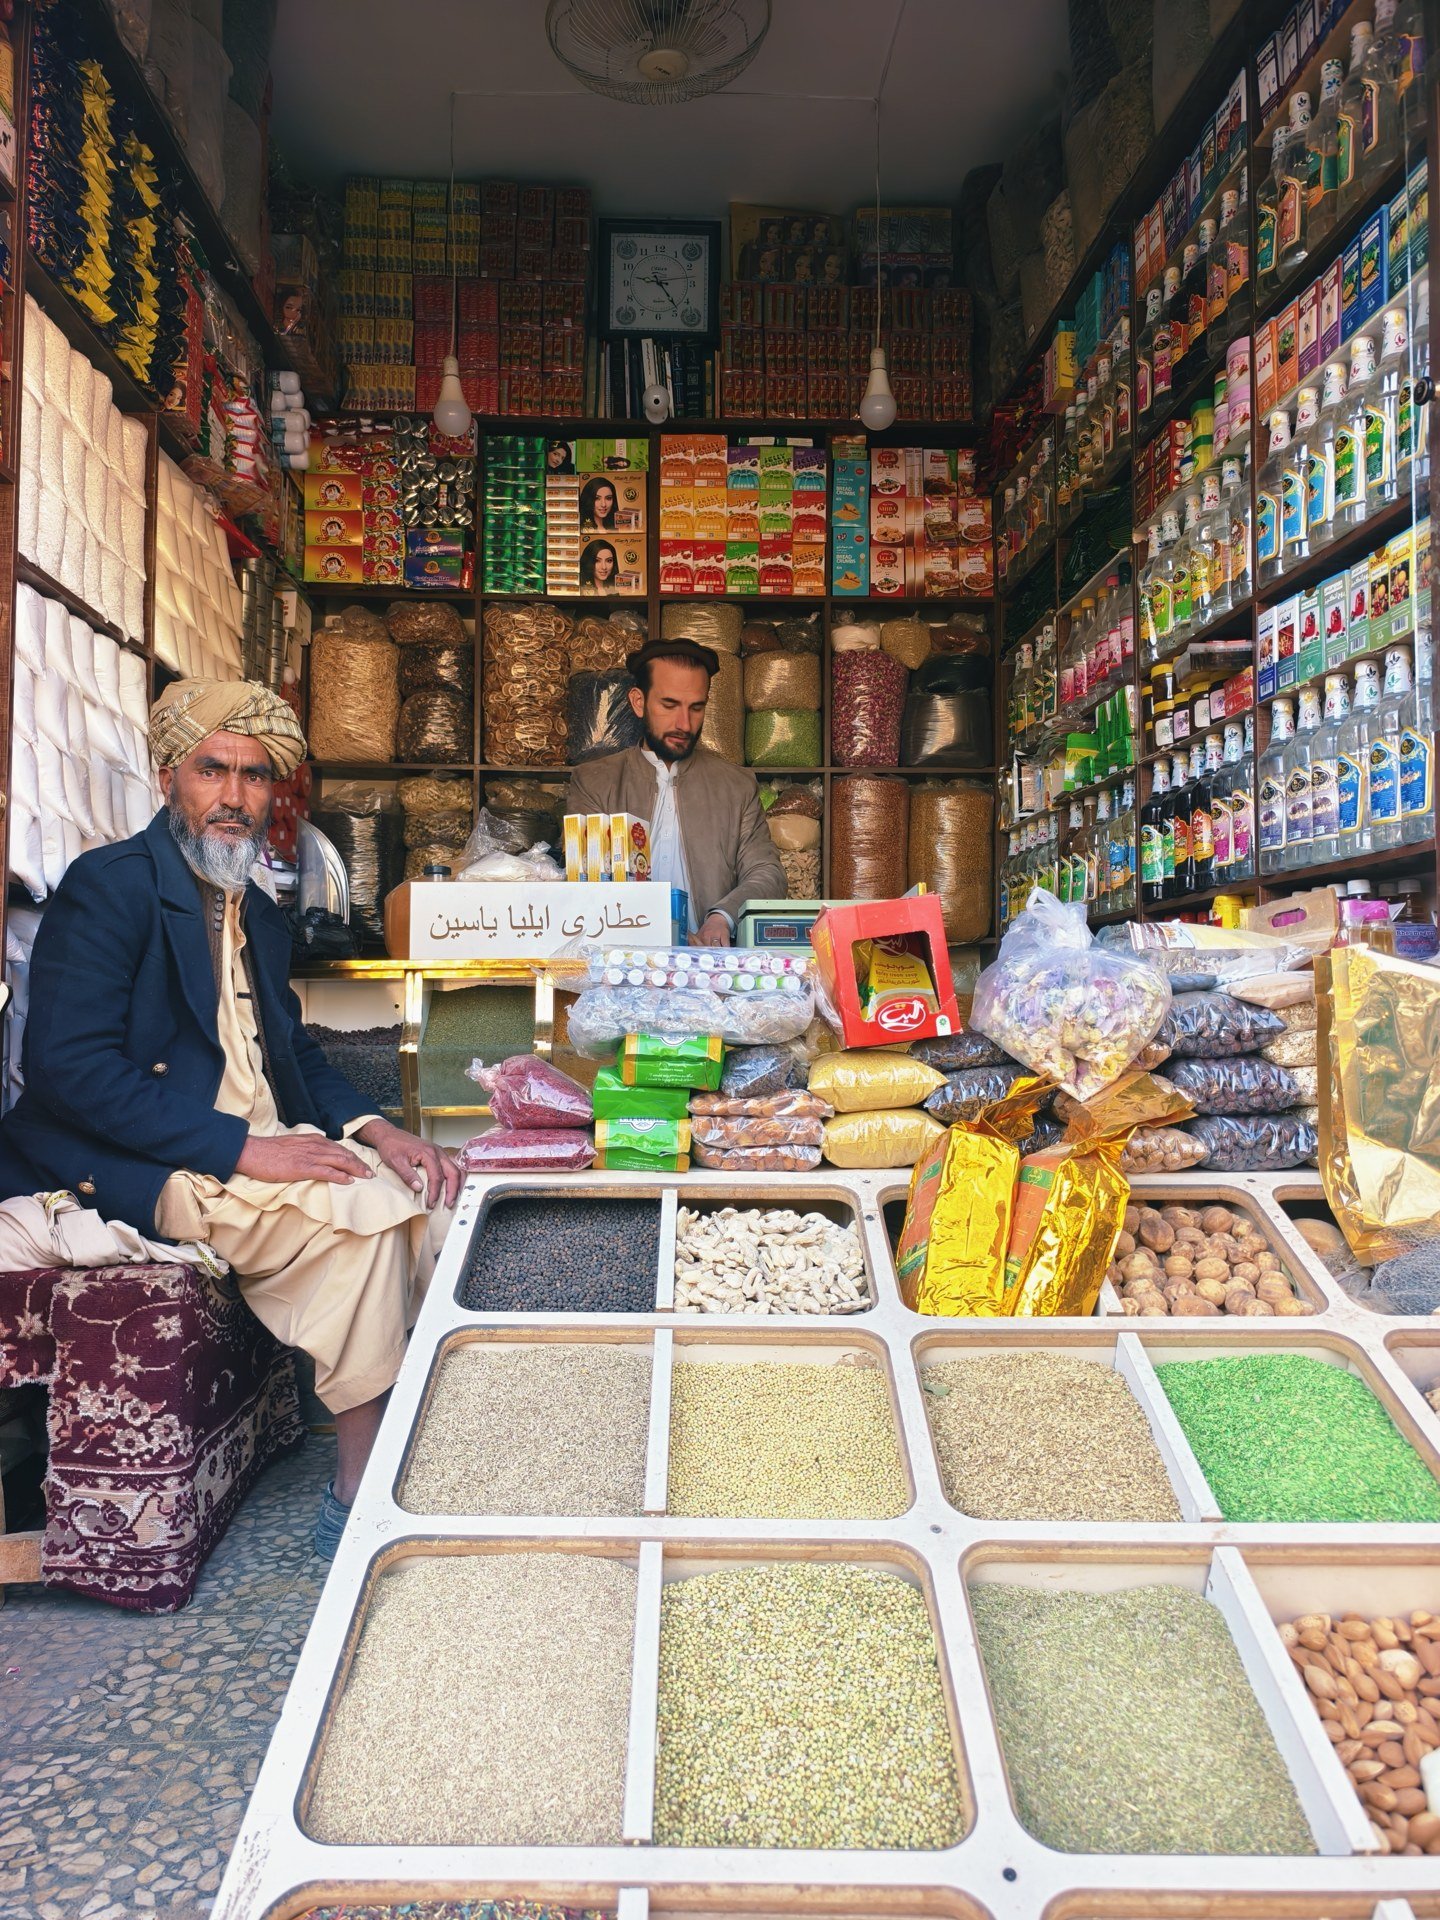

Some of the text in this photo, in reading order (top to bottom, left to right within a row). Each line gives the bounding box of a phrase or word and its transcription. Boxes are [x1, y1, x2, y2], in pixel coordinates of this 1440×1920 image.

[640, 248, 648, 256] 11
[655, 245, 666, 253] 12
[623, 263, 634, 271] 10
[686, 263, 693, 271] 2
[640, 308, 645, 316] 7
[671, 309, 678, 318] 5
[655, 313, 661, 321] 6
[429, 903, 651, 940] عطاری ایلیا یاسین
